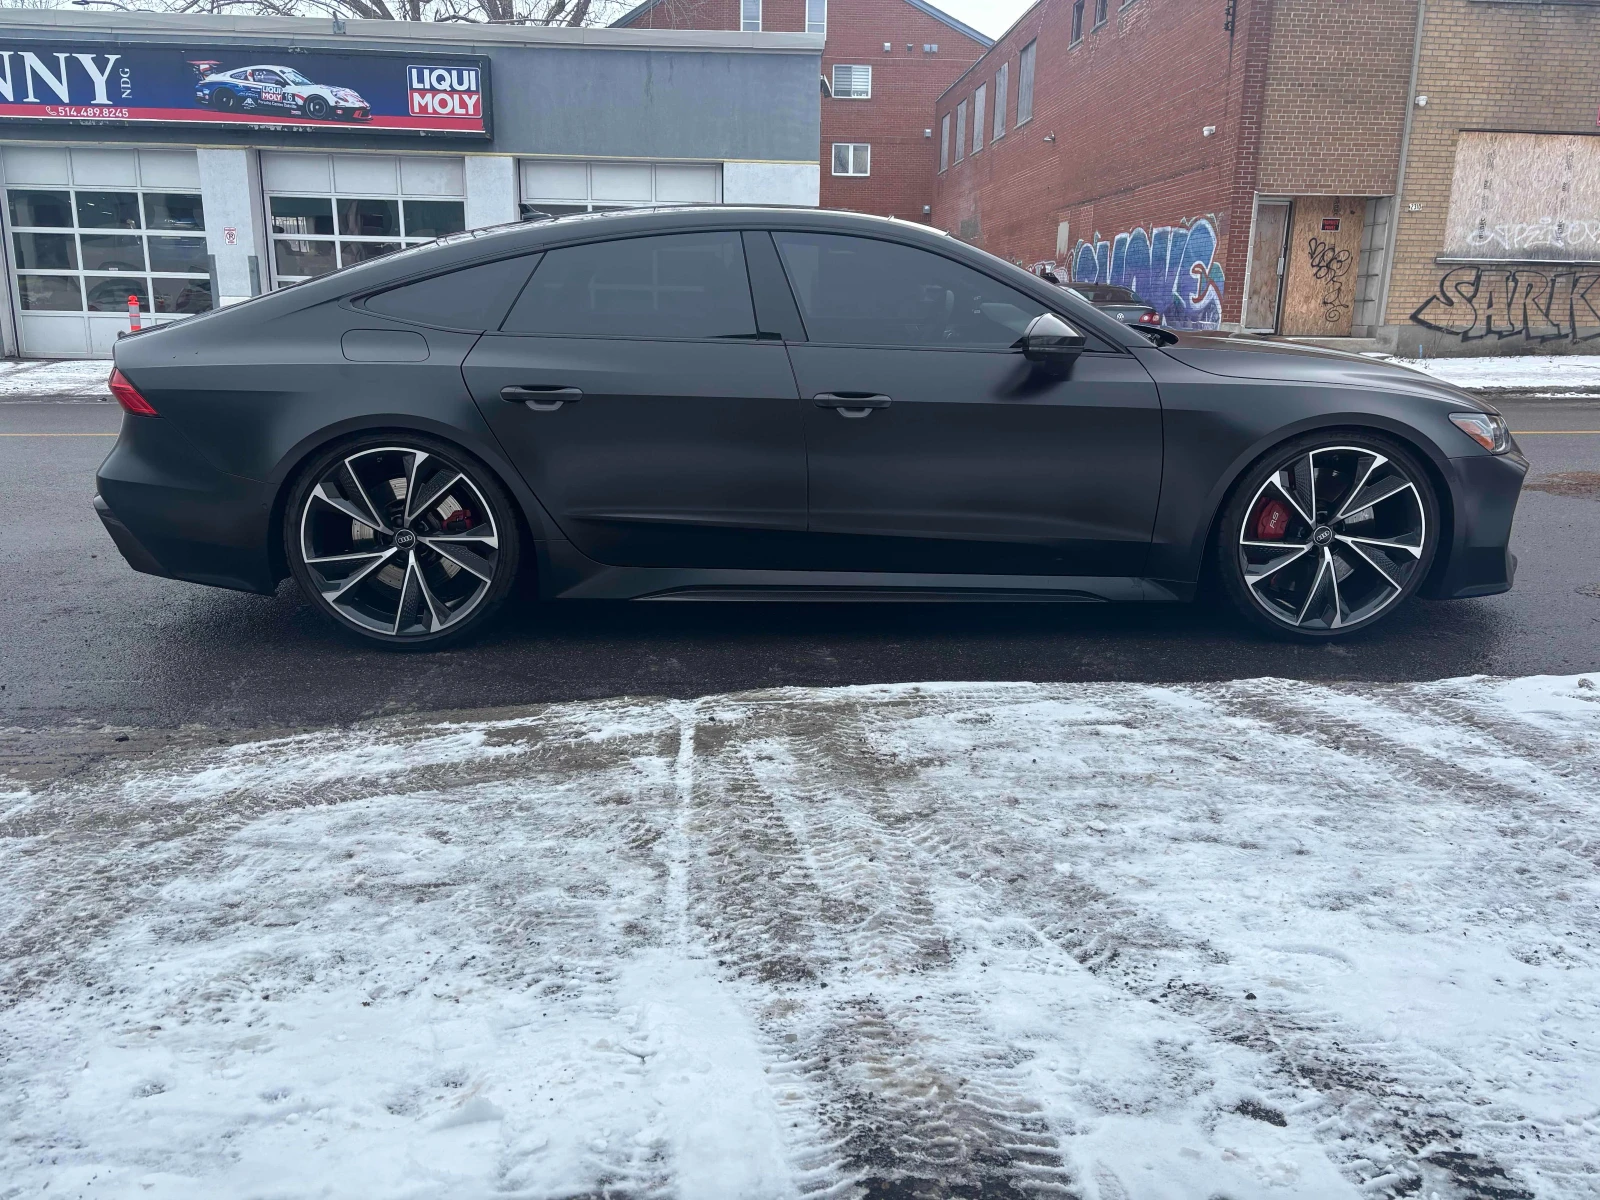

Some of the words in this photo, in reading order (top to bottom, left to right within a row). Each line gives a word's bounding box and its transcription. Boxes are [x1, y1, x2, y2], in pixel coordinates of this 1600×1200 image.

[0, 51, 121, 104] NY
[119, 68, 132, 98] NDG
[411, 68, 477, 91] LIQUI
[262, 86, 281, 94] LIQUI
[262, 93, 282, 101] MOLY
[284, 93, 293, 102] 16
[58, 107, 129, 117] 514.489.8245
[412, 93, 479, 114] MOLY
[1269, 511, 1279, 528] RS
